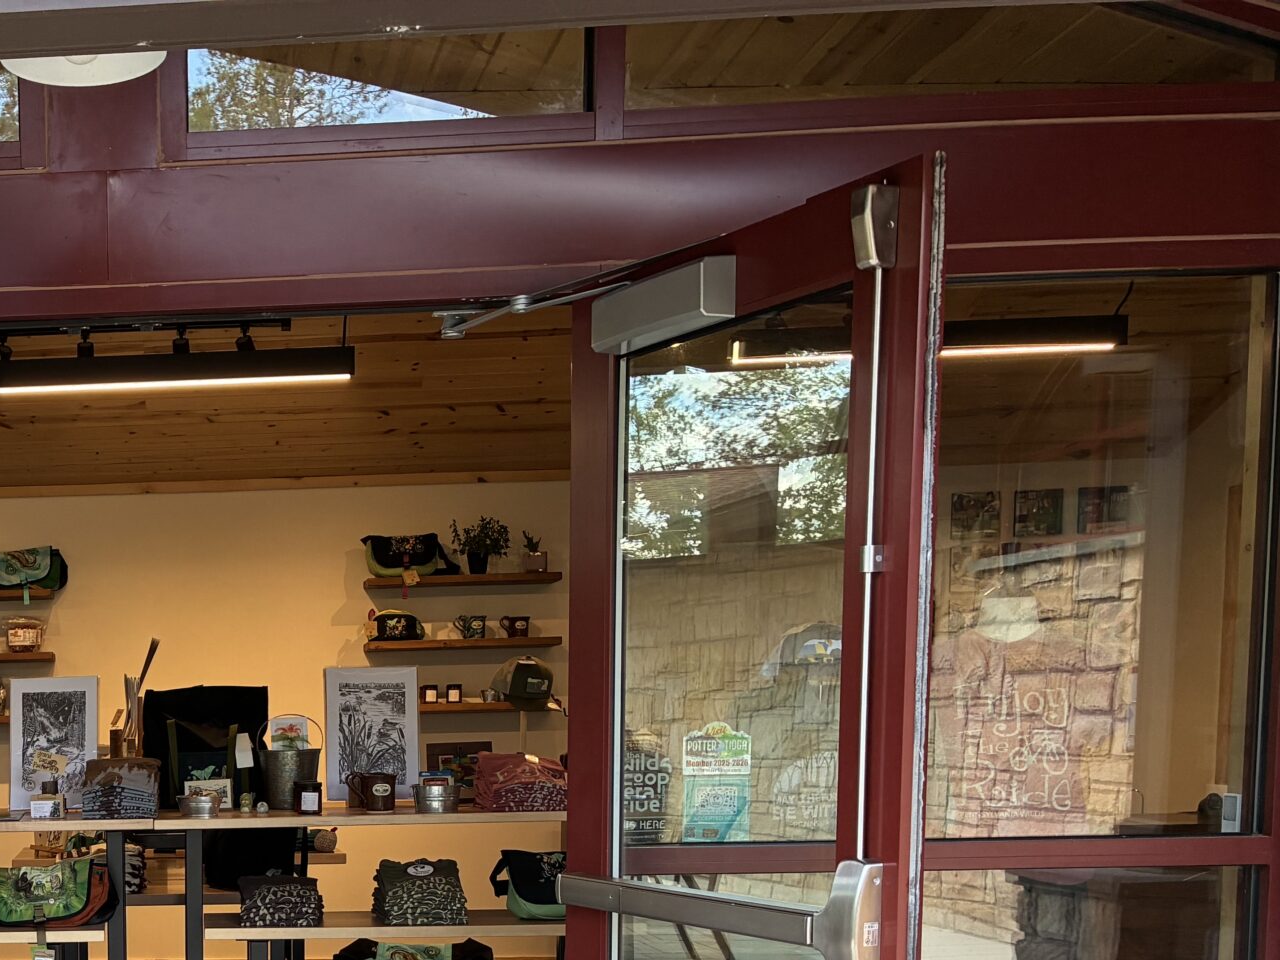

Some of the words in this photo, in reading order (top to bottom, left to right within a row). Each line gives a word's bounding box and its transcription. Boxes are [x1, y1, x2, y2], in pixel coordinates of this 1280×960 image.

[687, 740, 717, 752] POTTER
[724, 739, 749, 751] TIOGA
[686, 760, 713, 768] Member
